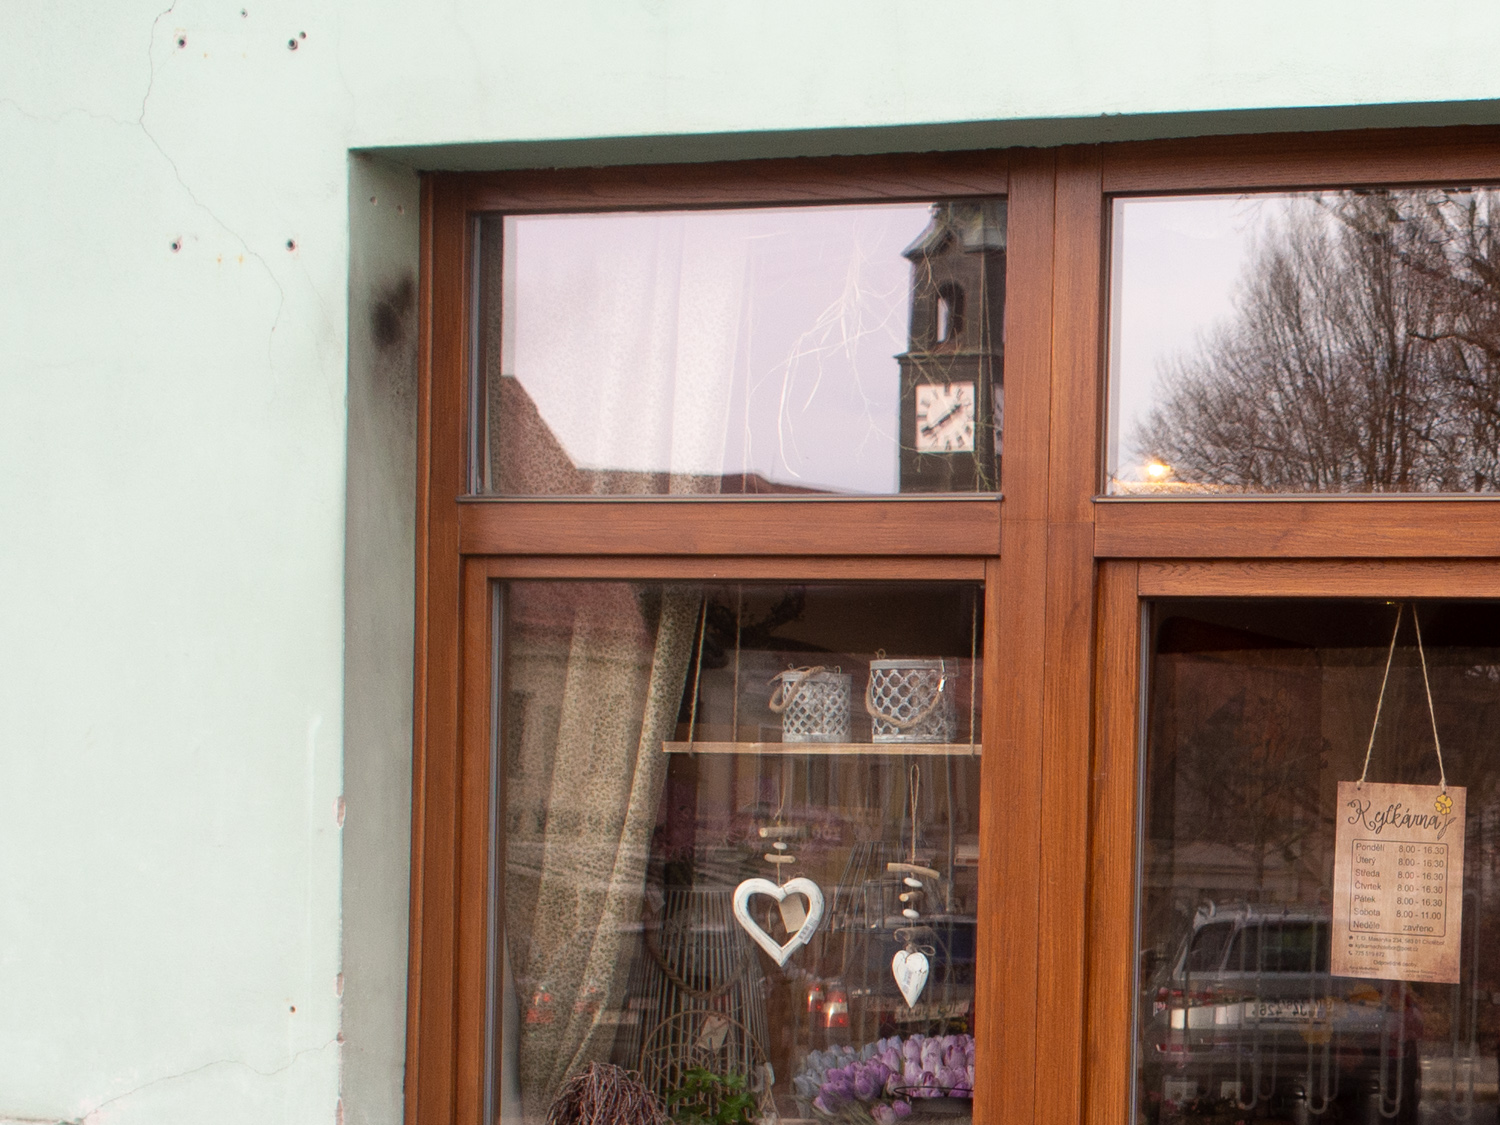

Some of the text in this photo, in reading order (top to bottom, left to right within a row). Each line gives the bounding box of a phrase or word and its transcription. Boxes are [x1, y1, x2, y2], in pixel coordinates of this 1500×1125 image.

[1355, 842, 1385, 852] Pondělí
[1398, 845, 1415, 853] 8.00
[1424, 846, 1445, 855] 16.30
[1355, 853, 1376, 866] Úterý
[1398, 858, 1415, 866] 8.00
[1423, 859, 1444, 868] 16.30
[1355, 868, 1380, 877] Středa
[1397, 871, 1415, 879] 8.00
[1422, 872, 1444, 881] 16.30
[1354, 880, 1382, 890] Čtvrtek
[1397, 883, 1414, 892] 8.00
[1422, 885, 1443, 894] 16.30
[1354, 894, 1376, 903] Pátek
[1396, 897, 1414, 905] 8.00
[1421, 898, 1443, 907] 16.30
[1353, 908, 1380, 916] Sobota
[1396, 909, 1413, 918] 8.00
[1421, 911, 1442, 920] 11.00
[1353, 920, 1434, 932] Neděle zavřeno
